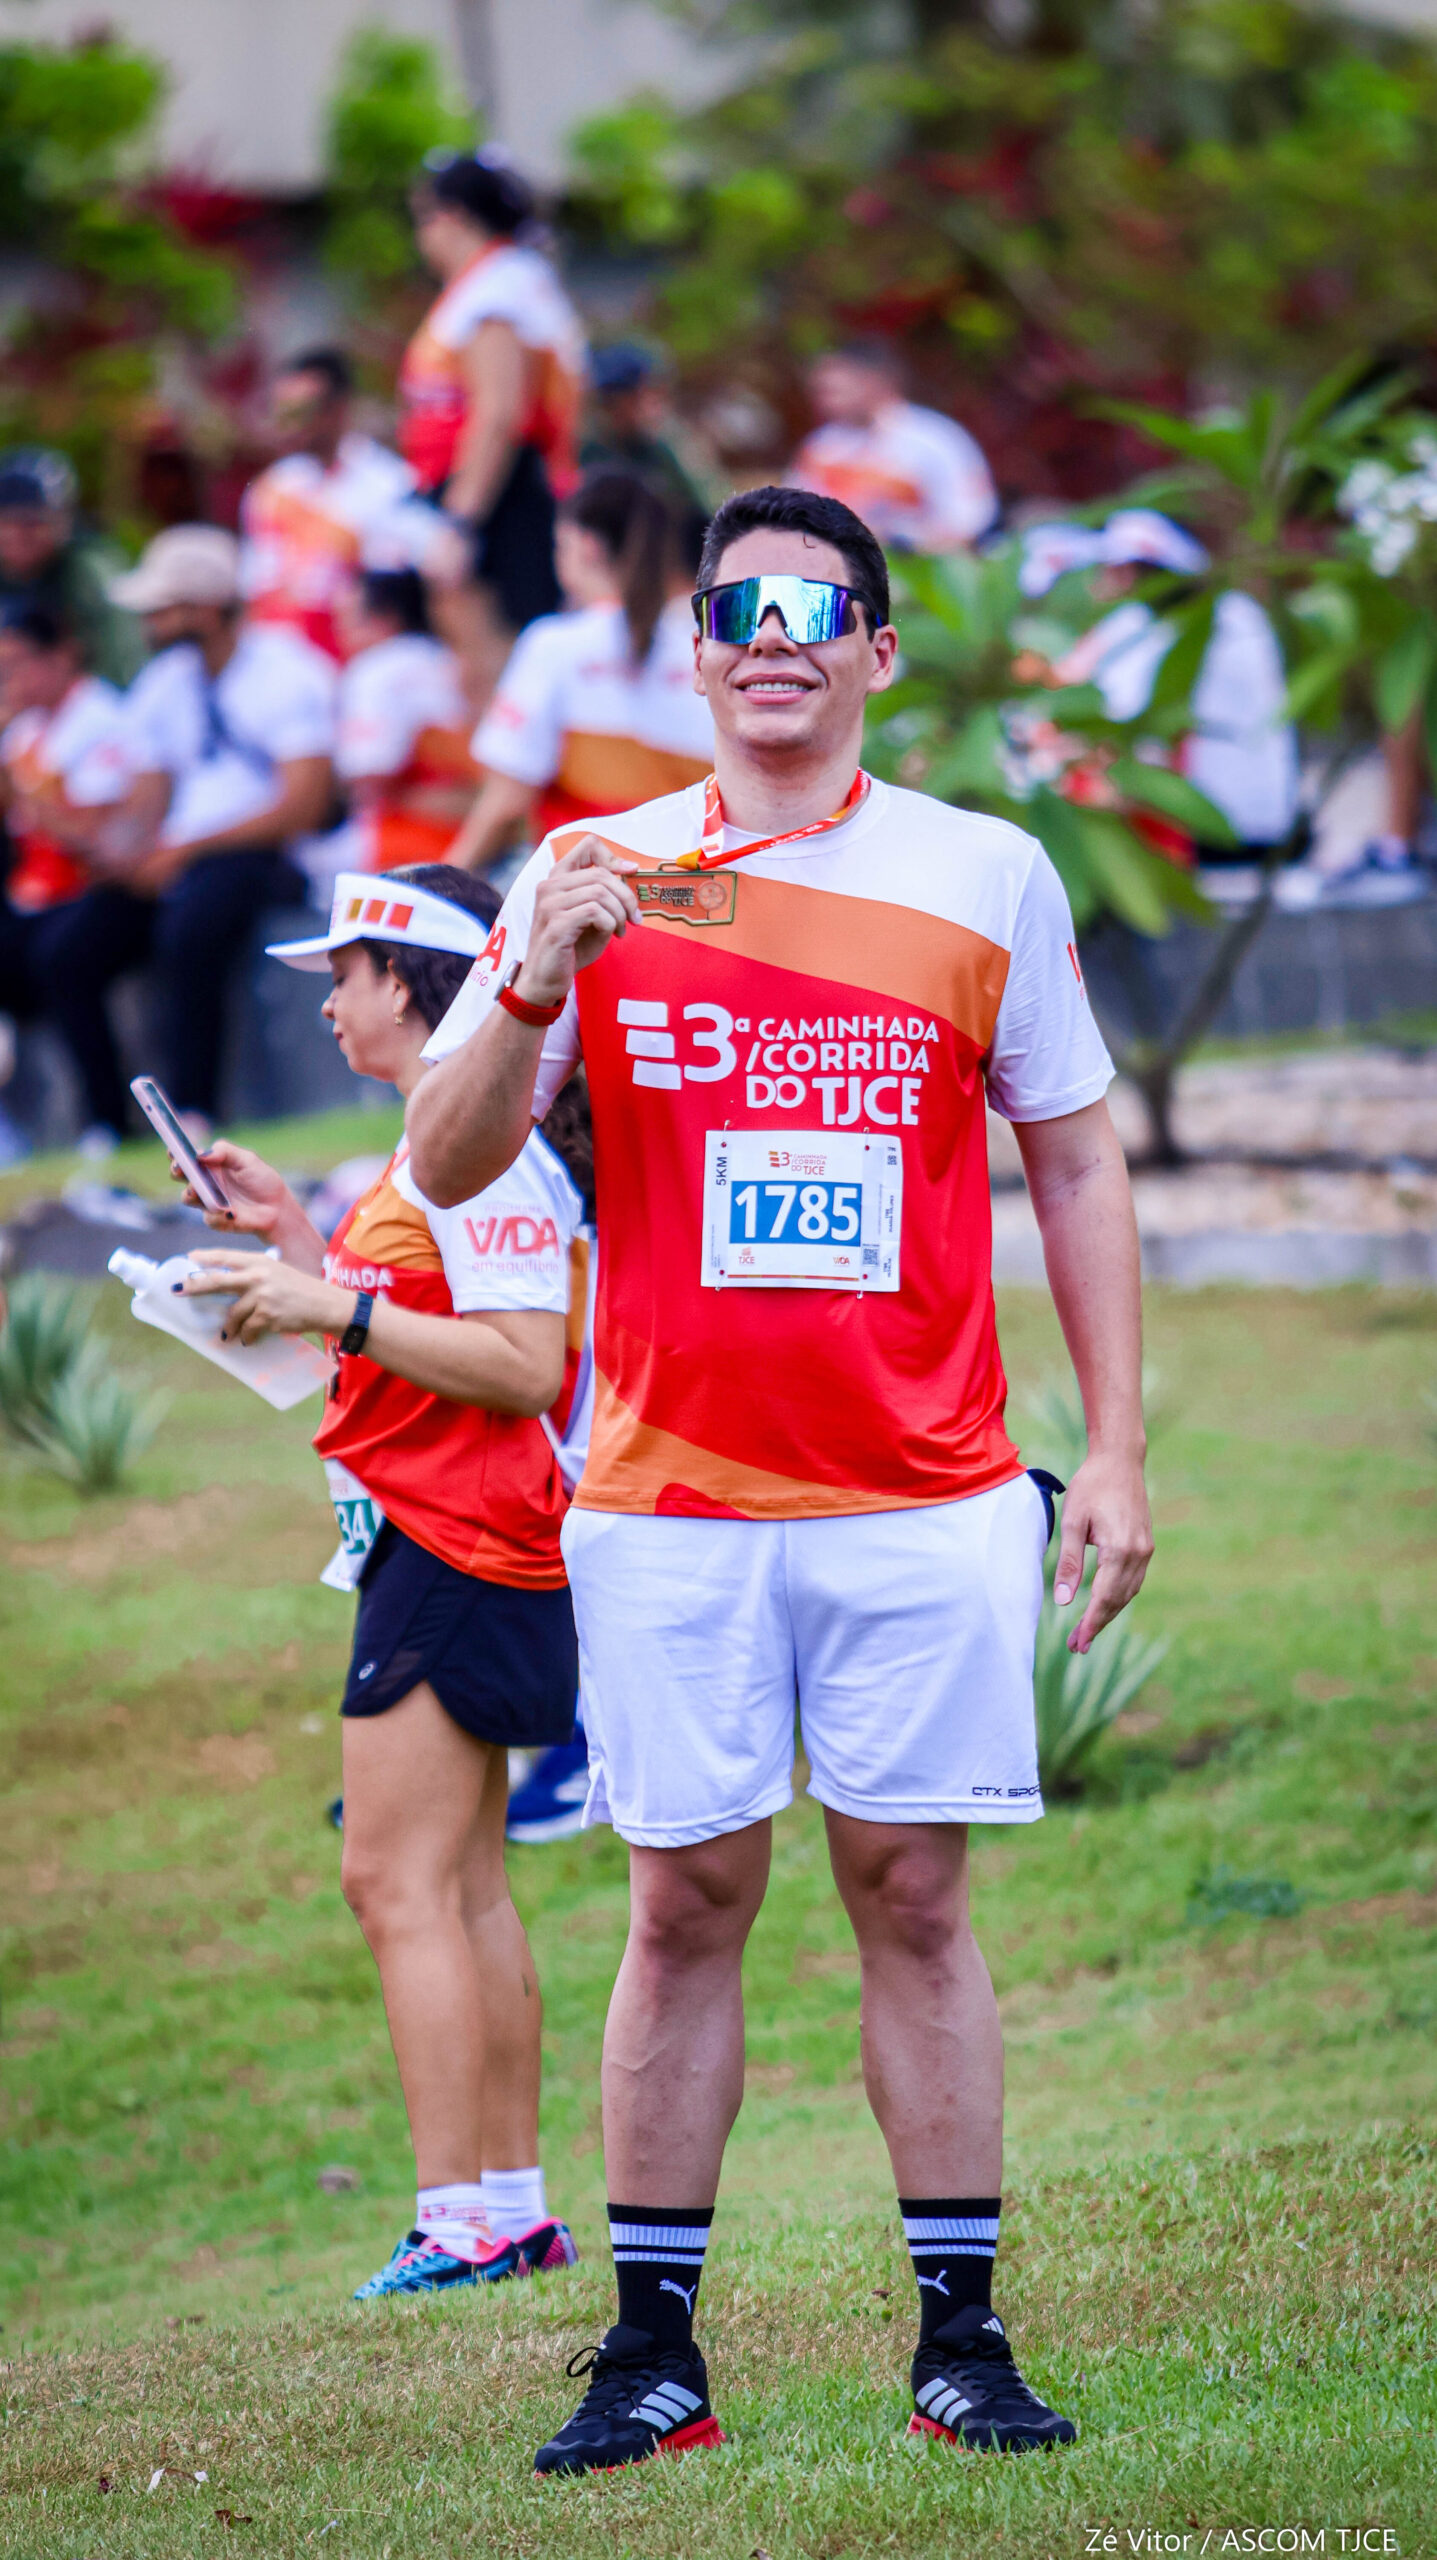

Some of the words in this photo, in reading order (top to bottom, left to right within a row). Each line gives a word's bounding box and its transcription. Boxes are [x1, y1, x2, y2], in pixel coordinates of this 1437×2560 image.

[757, 1015, 940, 1043] CAMINHADA
[745, 1041, 931, 1073] /CORRIDA
[746, 1074, 806, 1109] DO
[811, 1076, 923, 1126] TJCE
[716, 1156, 728, 1186] 5KM
[803, 1165, 825, 1175] TJCE
[735, 1185, 860, 1242] 1785
[738, 1256, 755, 1264] TJCE
[972, 1786, 1002, 1796] CTX
